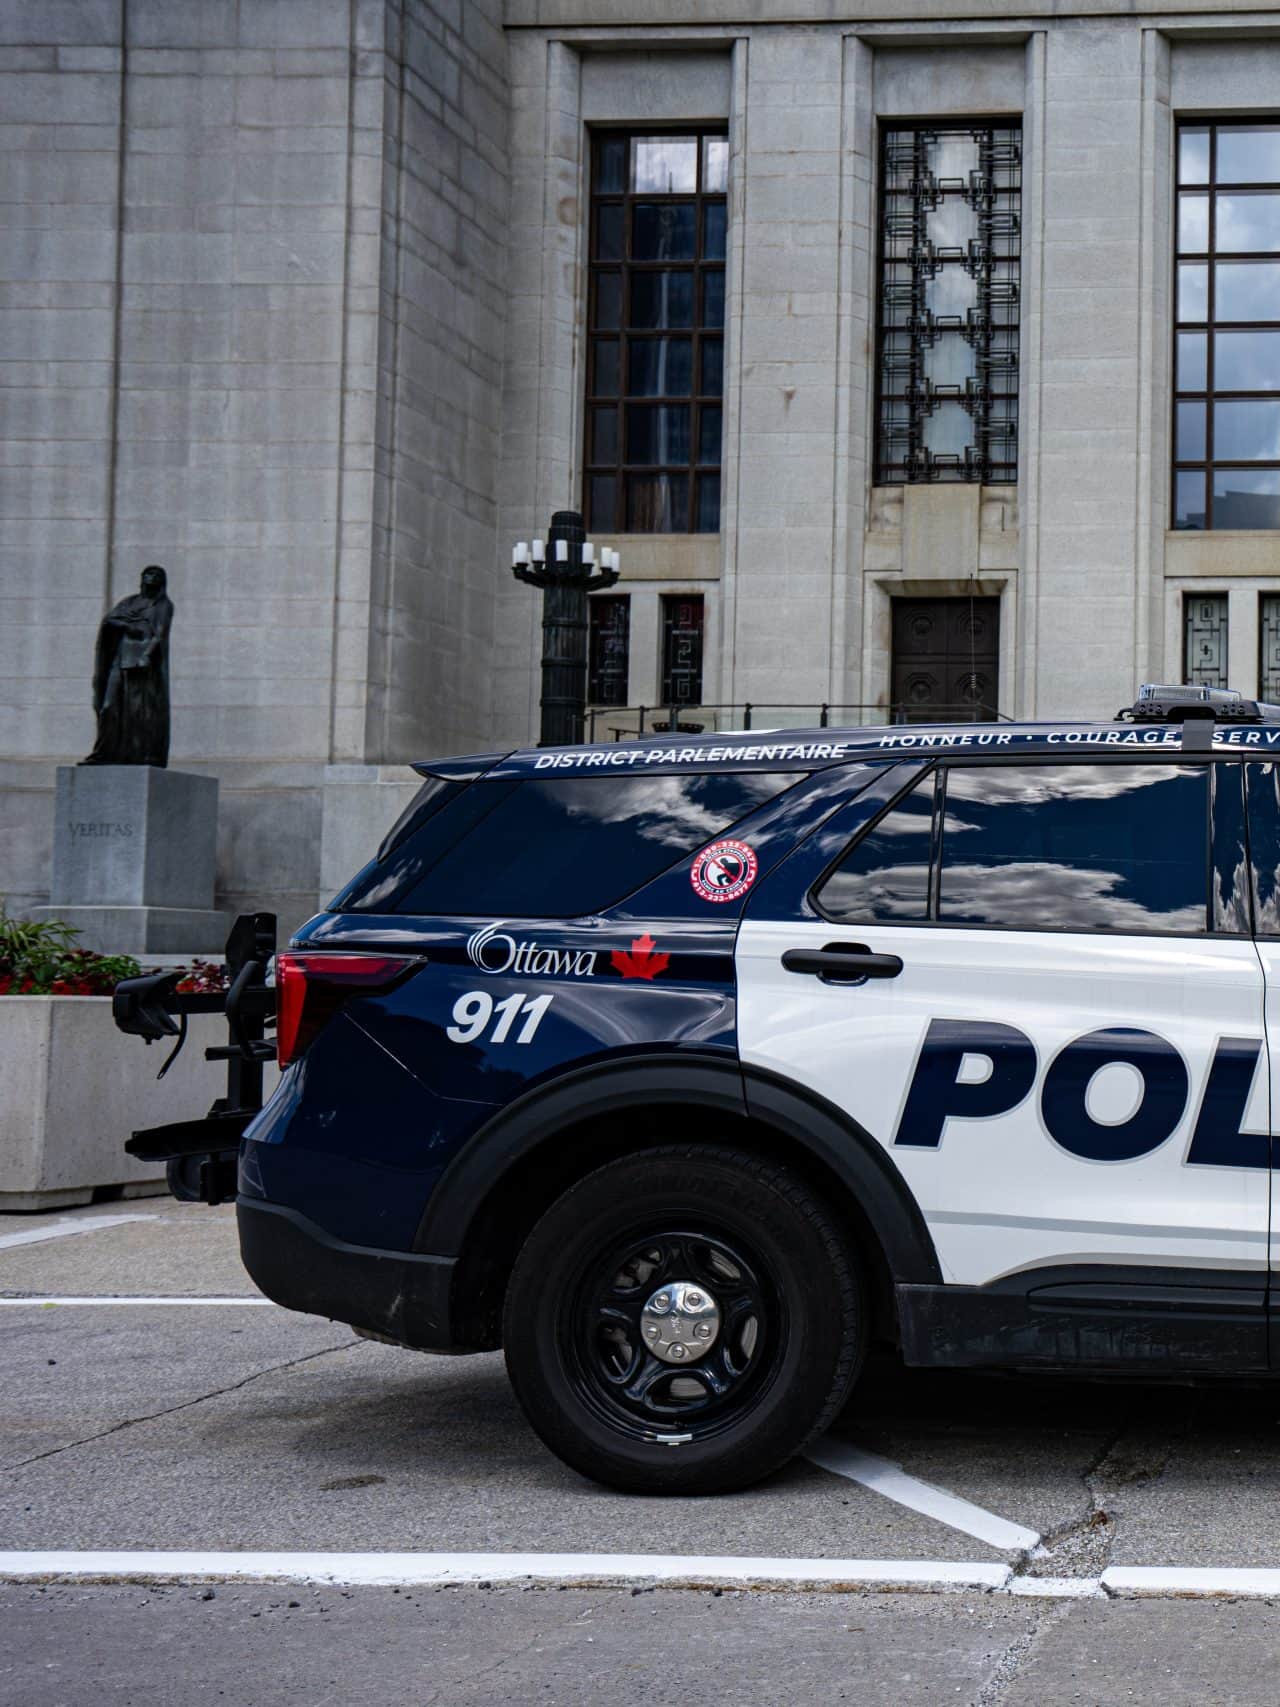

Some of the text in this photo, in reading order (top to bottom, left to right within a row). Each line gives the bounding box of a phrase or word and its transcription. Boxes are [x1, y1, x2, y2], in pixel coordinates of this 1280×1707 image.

[879, 732, 1013, 748] HONNEUR
[1046, 730, 1177, 744] COURAGE
[534, 743, 849, 769] DISTRICT PARLEMENTAIRE
[68, 823, 134, 837] VERITAS
[467, 921, 598, 976] Ottawa
[446, 991, 554, 1044] 911
